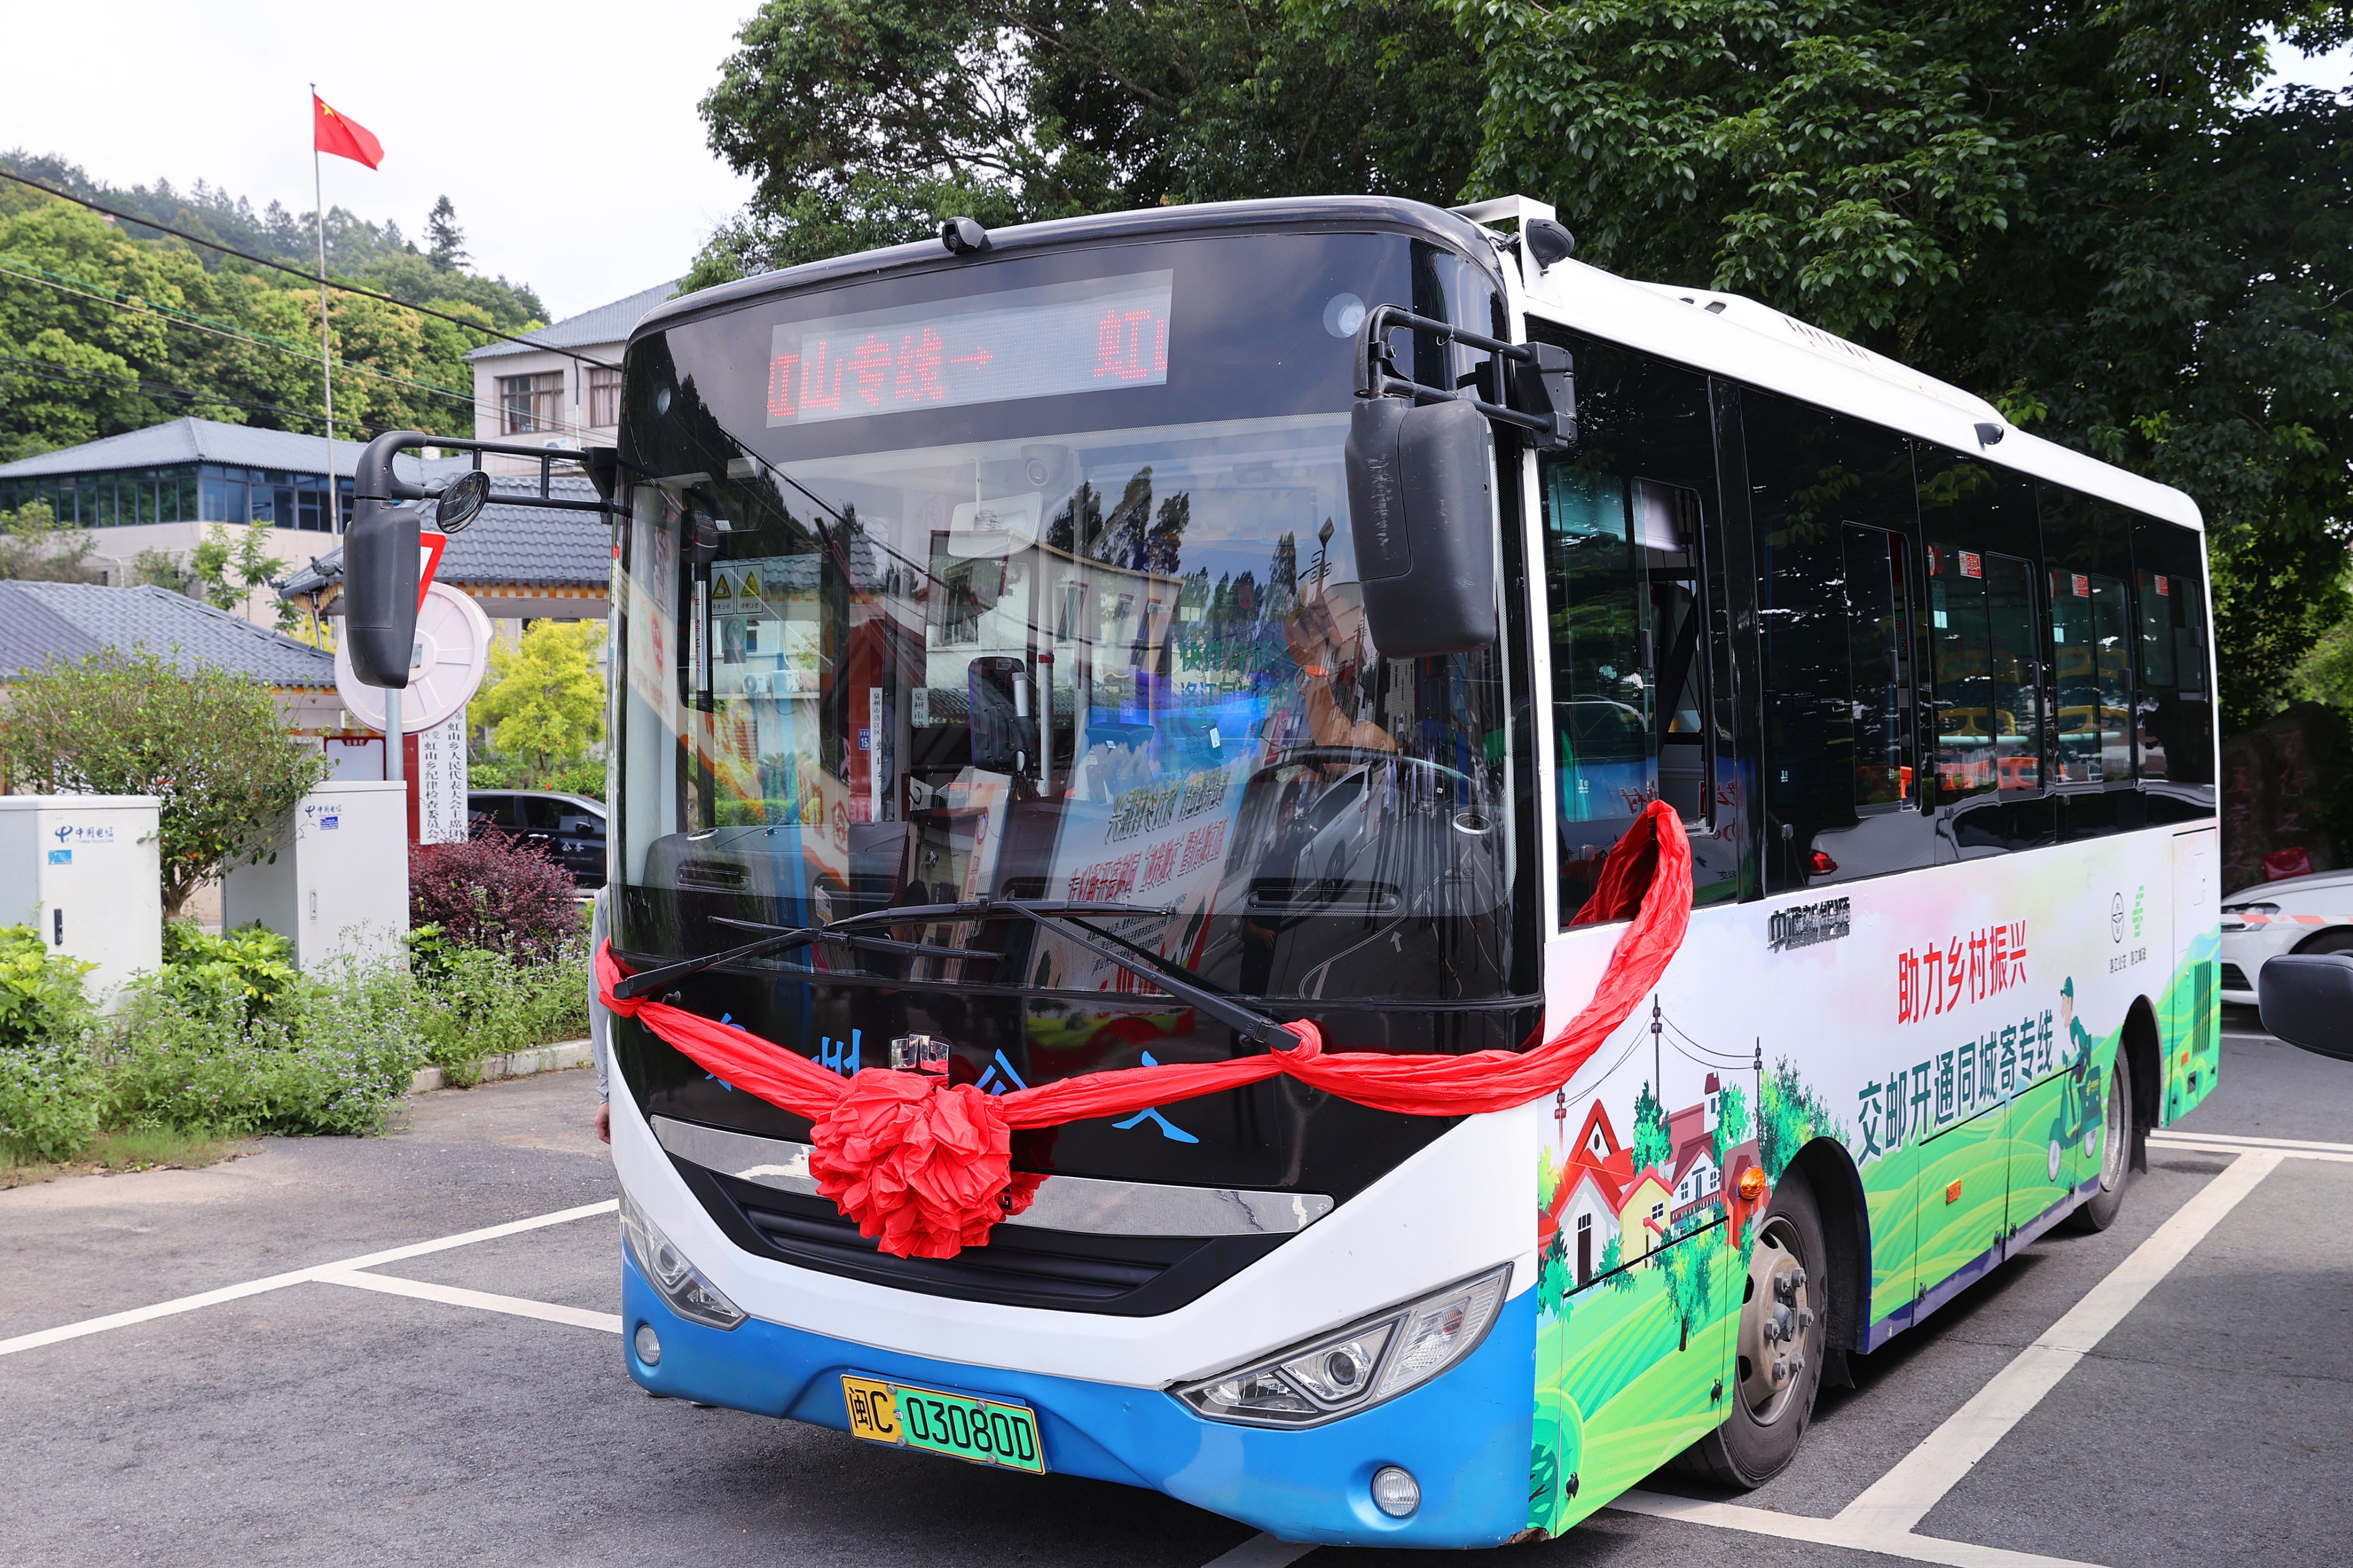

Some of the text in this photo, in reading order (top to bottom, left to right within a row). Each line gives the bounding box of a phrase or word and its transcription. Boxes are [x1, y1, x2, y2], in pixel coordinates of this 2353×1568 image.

[1093, 309, 1167, 379] 虹
[424, 741, 439, 839] 虹山乡纪律检查委员会
[447, 721, 462, 839] 虹山乡人民代表大会主席团
[75, 826, 114, 839] 中国电信
[1898, 920, 2027, 1025] 助力乡村振兴
[1857, 1010, 2053, 1167] 交邮开通同城寄专线
